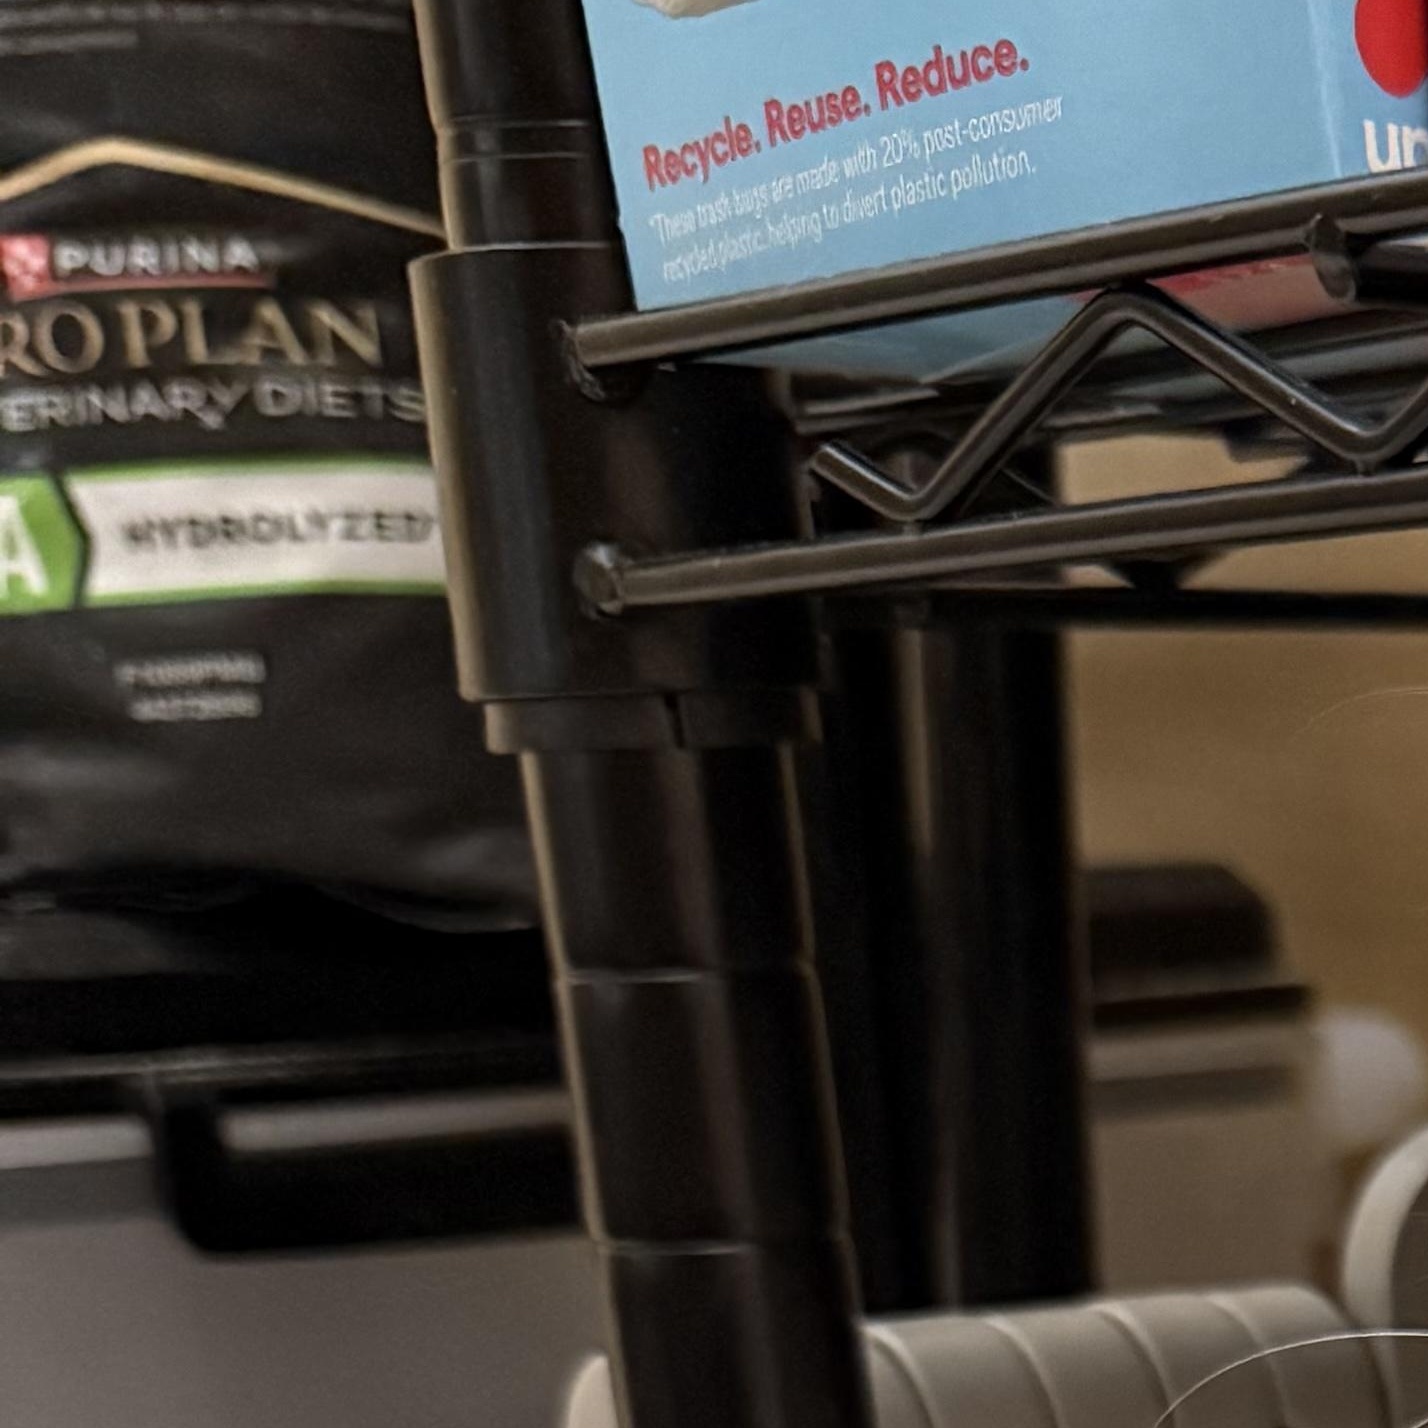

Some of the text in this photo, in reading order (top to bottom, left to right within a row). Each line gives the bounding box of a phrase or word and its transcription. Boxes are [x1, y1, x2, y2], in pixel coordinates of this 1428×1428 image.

[642, 38, 1030, 193] Recycle. Reuse. Reduce.
[772, 174, 794, 203] are
[796, 155, 841, 194] made
[842, 139, 878, 180] with
[880, 127, 921, 168] 20%
[922, 95, 1064, 164] post-consumer
[767, 212, 823, 251] helping
[823, 202, 841, 231] to
[842, 183, 888, 224] divert
[890, 166, 947, 217] plastic
[950, 147, 1037, 201] pollution.
[54, 235, 261, 282] PURINA
[115, 296, 384, 369] PLAN
[253, 373, 428, 424] DIETS
[121, 508, 437, 554] HYDROLYZED
